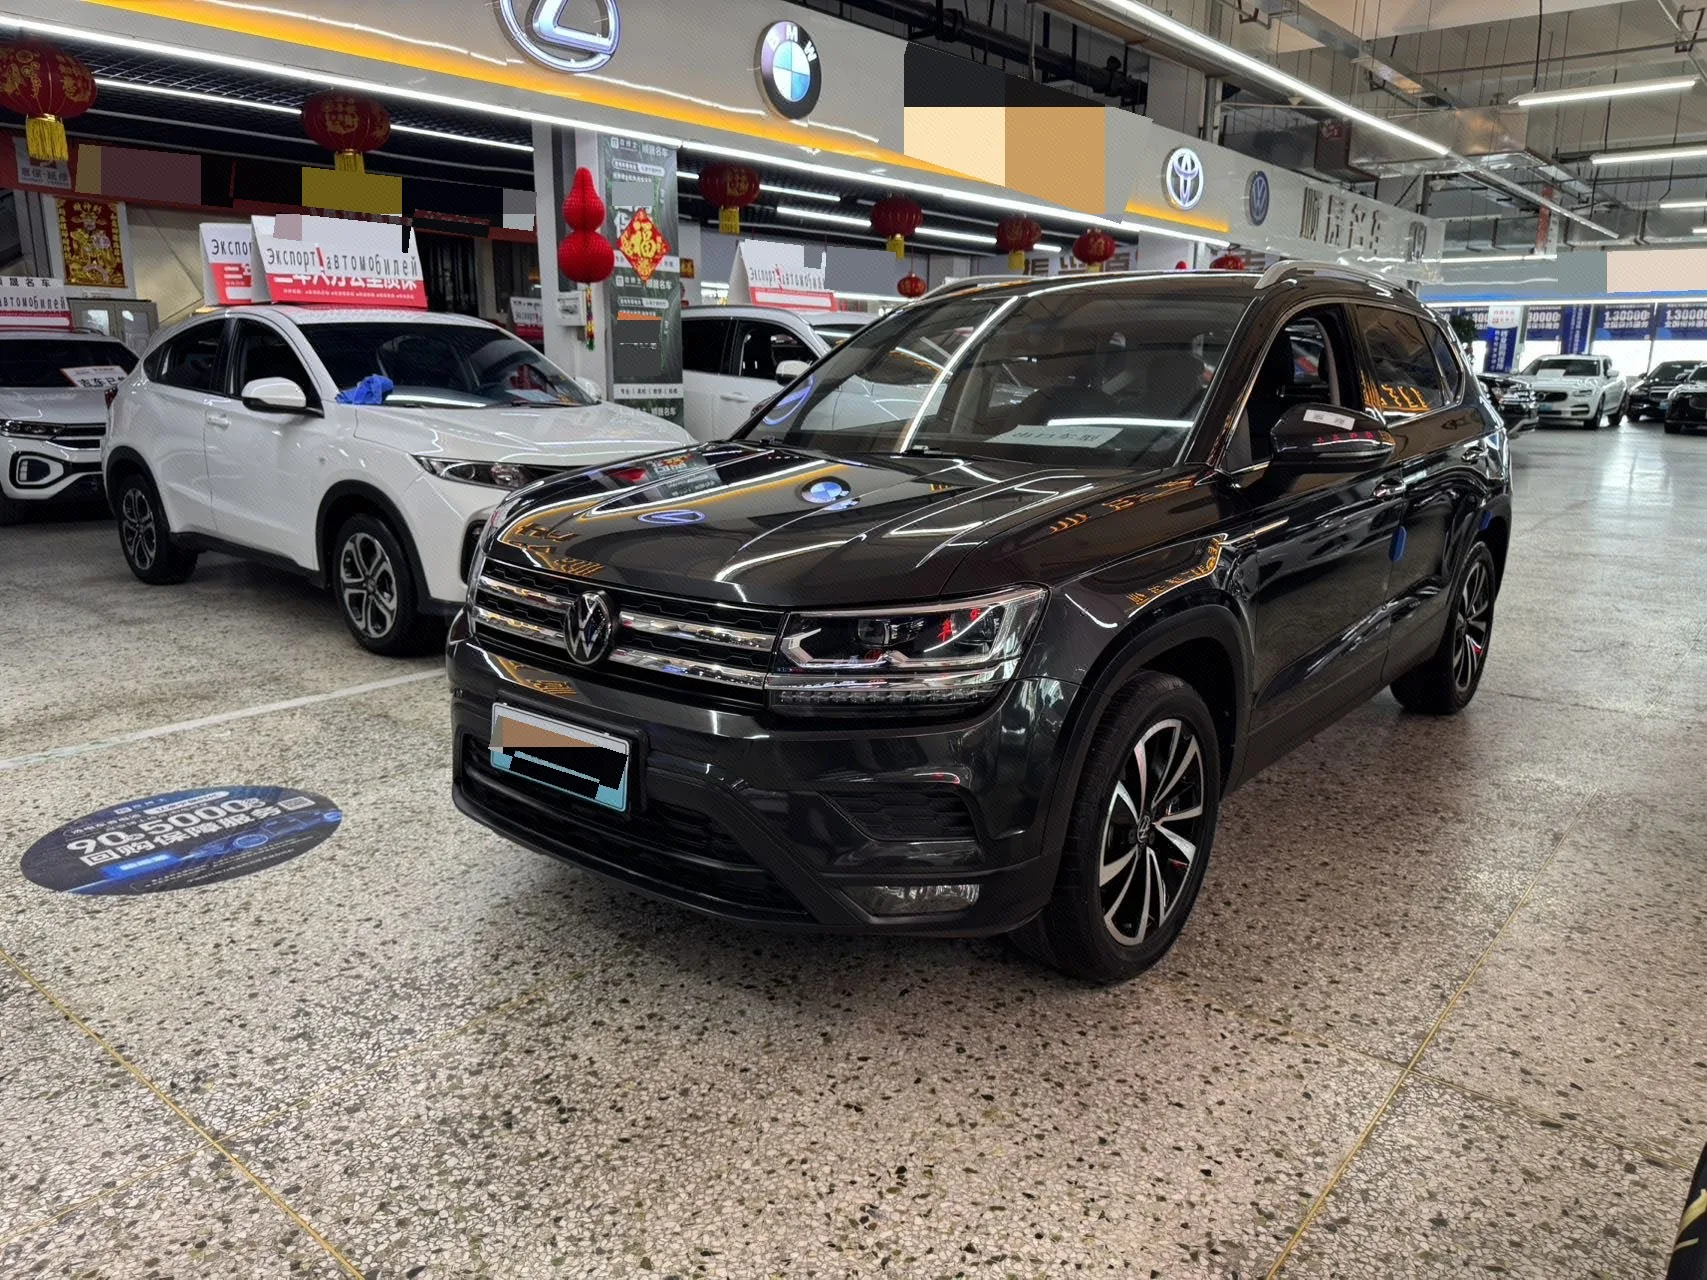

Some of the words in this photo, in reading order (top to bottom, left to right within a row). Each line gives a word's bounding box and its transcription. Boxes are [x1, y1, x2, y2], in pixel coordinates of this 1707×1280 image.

[211, 238, 252, 257] Экспо
[267, 247, 315, 272] Экспорт
[326, 252, 418, 277] автомобилей
